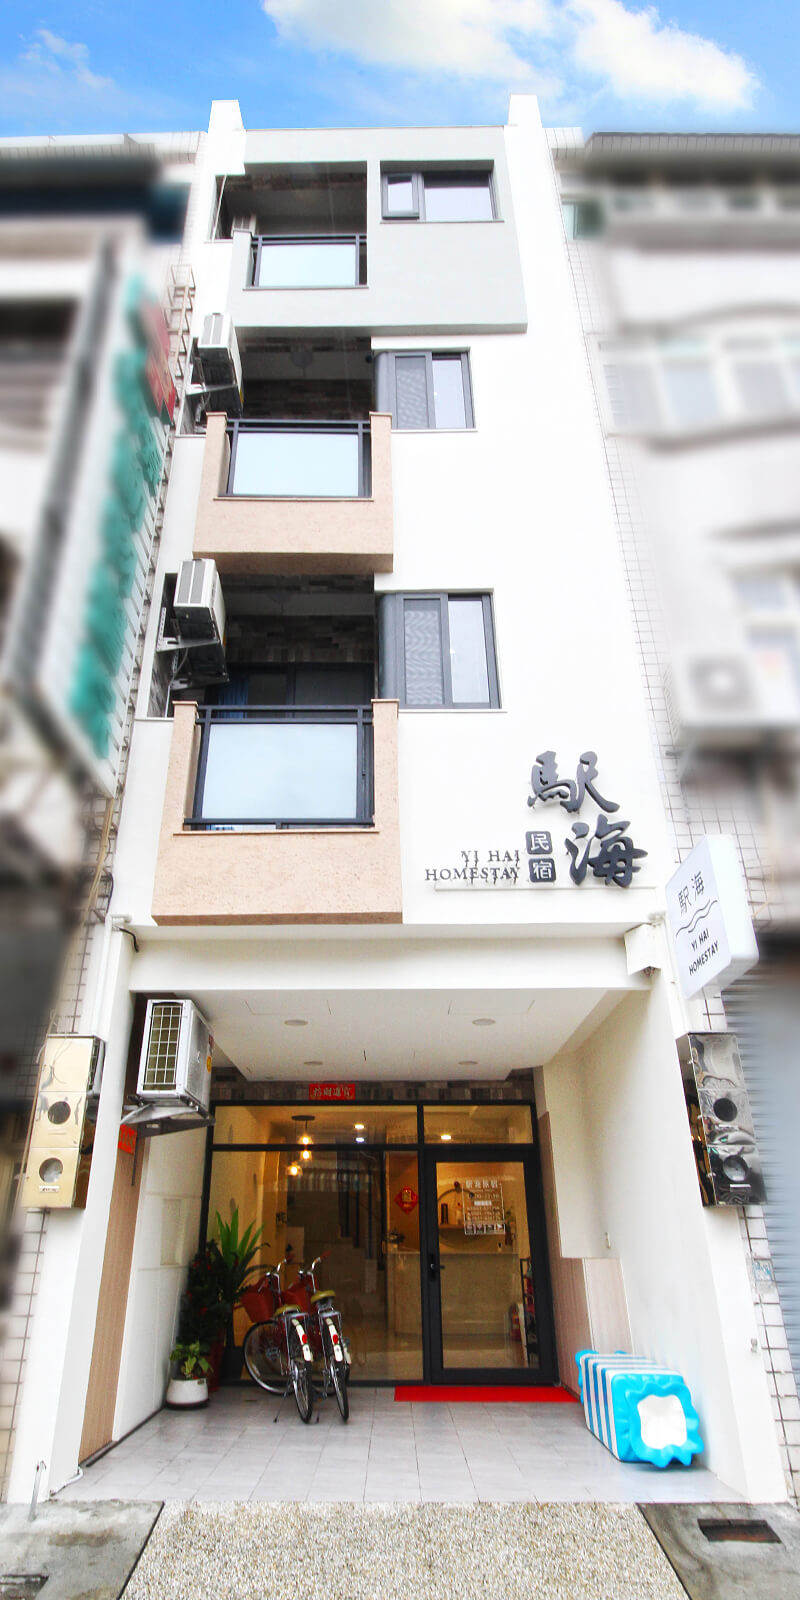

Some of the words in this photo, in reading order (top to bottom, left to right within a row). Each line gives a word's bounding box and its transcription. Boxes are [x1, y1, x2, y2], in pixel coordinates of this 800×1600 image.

[461, 850, 479, 862] YI
[488, 850, 520, 862] HAI
[530, 833, 552, 880] 民宿
[425, 867, 520, 881] HOMESTAY
[691, 939, 698, 952] YI
[699, 927, 710, 945] HAI
[688, 940, 719, 976] HOMESTAY
